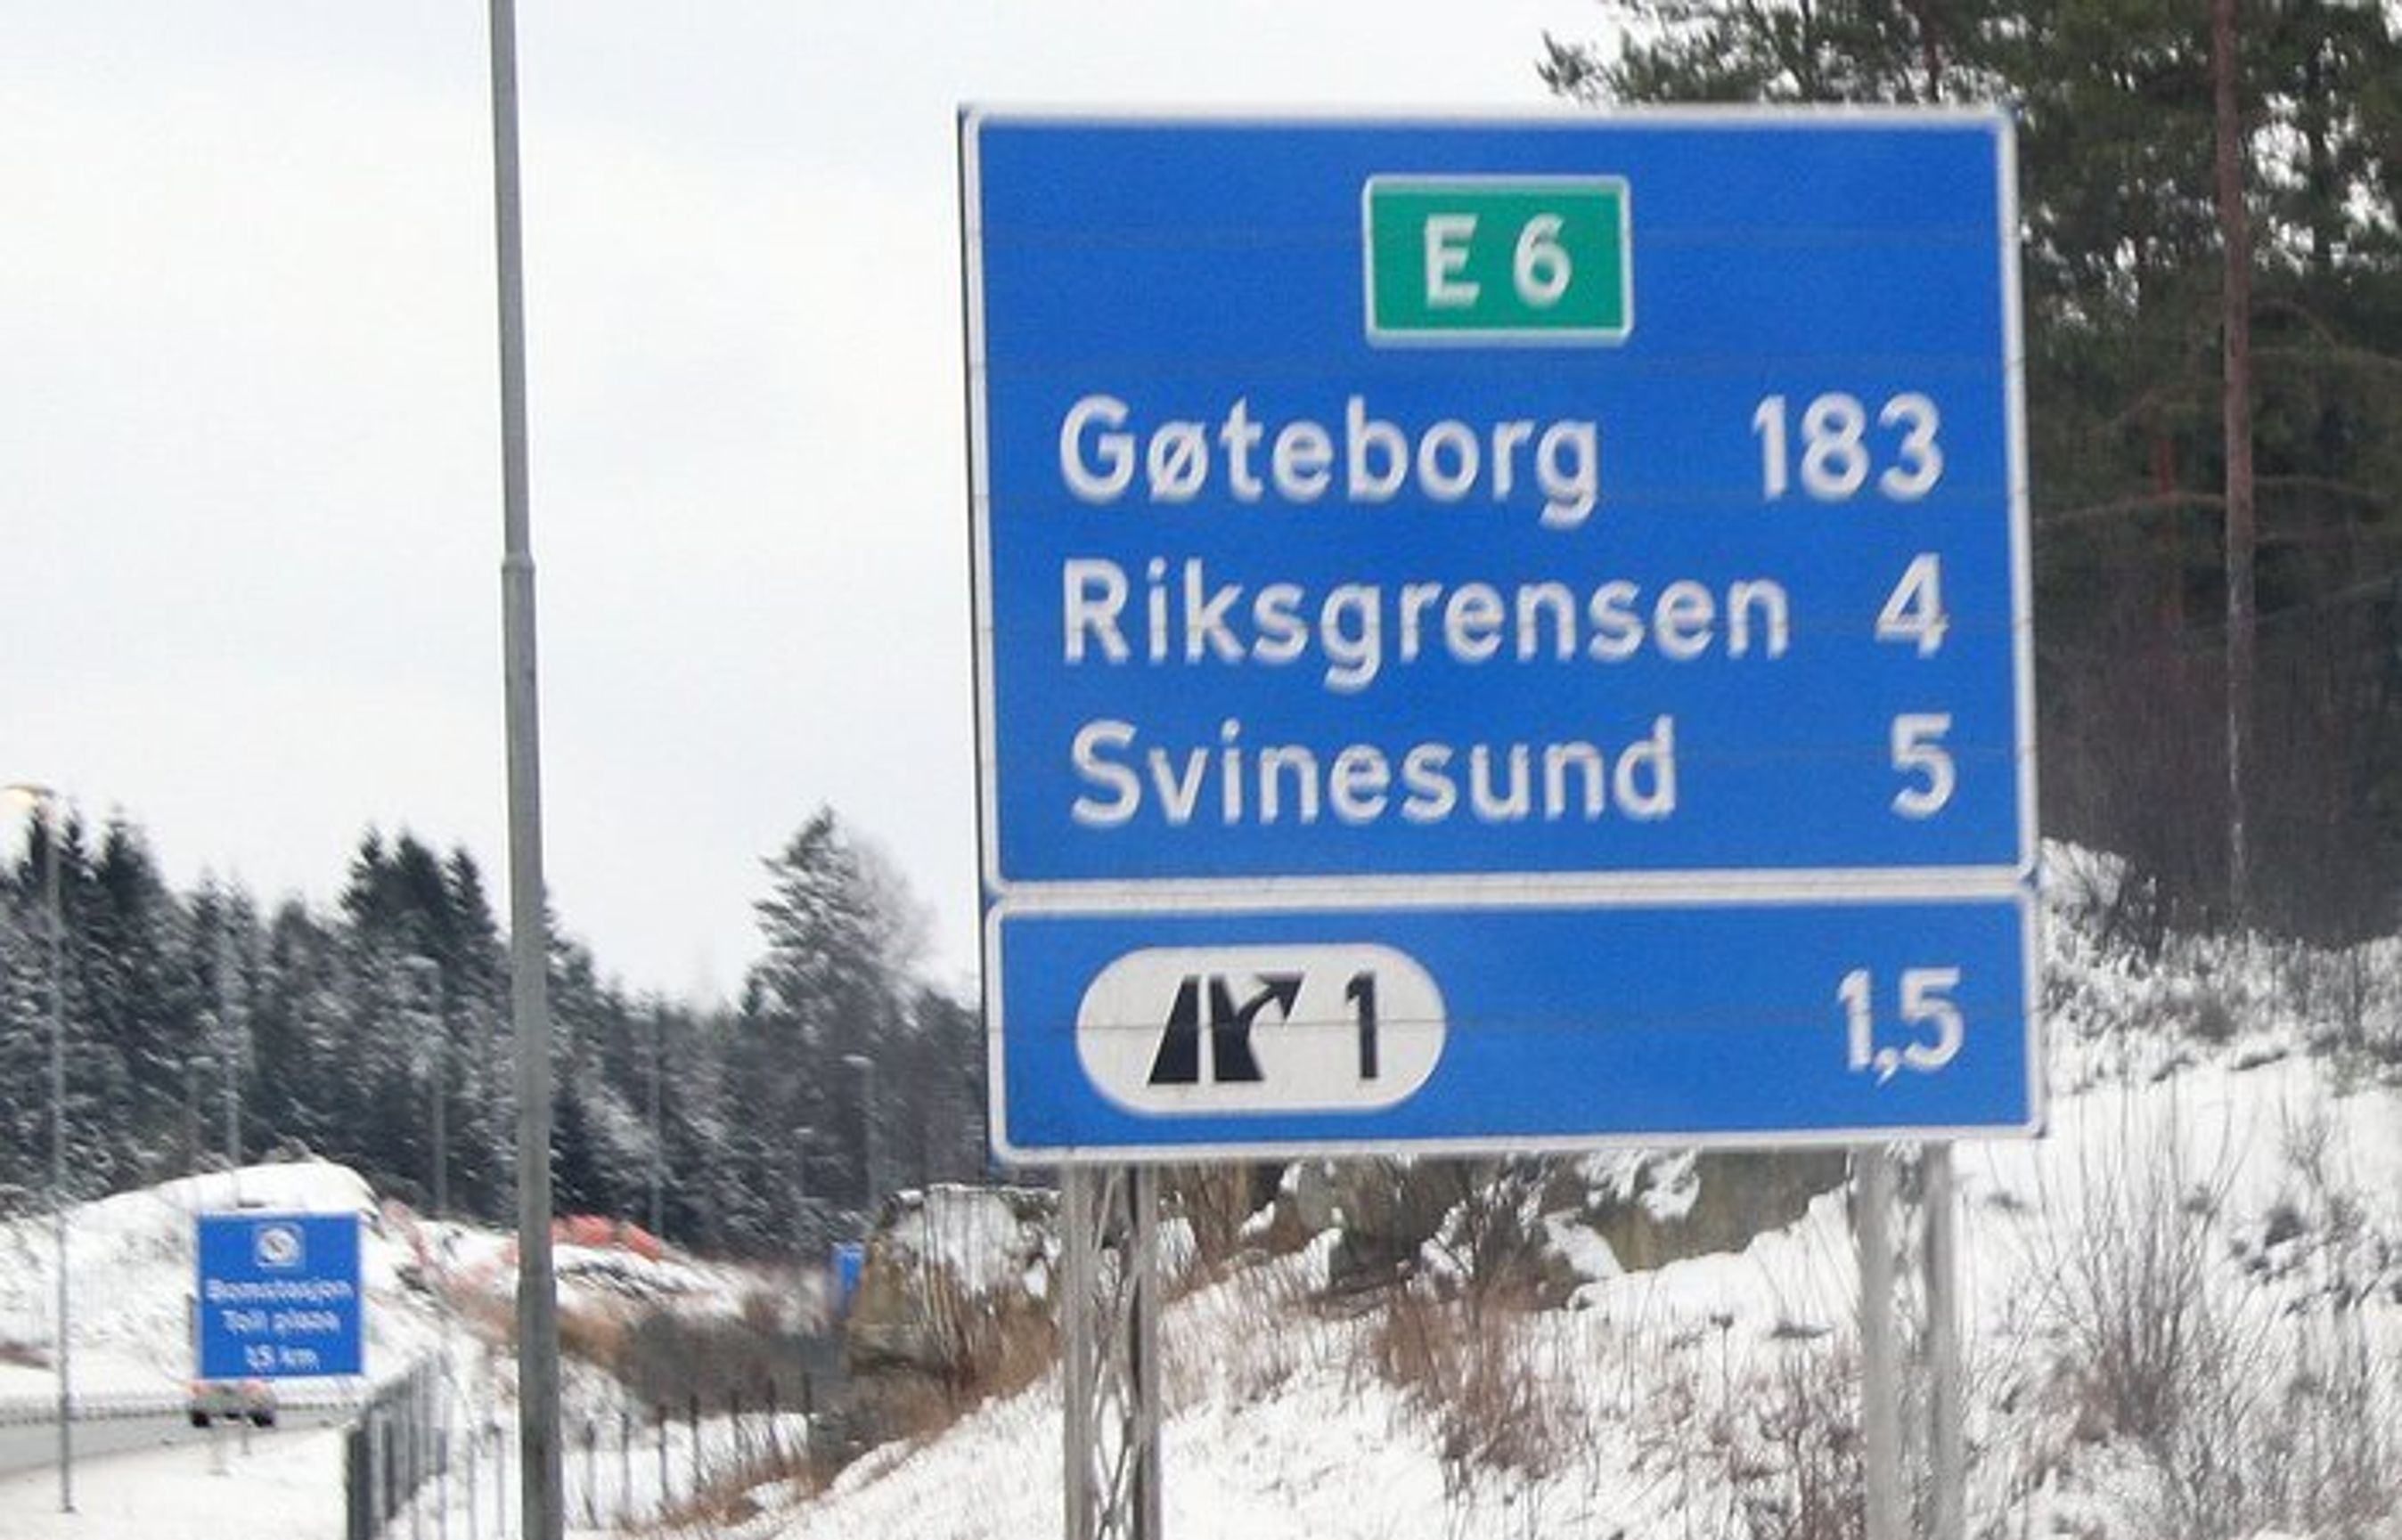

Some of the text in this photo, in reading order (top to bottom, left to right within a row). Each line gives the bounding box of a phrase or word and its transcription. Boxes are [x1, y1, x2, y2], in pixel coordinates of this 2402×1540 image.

[1423, 213, 1573, 307] E 6
[1059, 393, 1945, 530] Gøteborg 183
[1063, 553, 1950, 693] Riksgrensen 4
[1071, 713, 1957, 828] Svinesund 5
[1344, 966, 1965, 1085] 1 1,5
